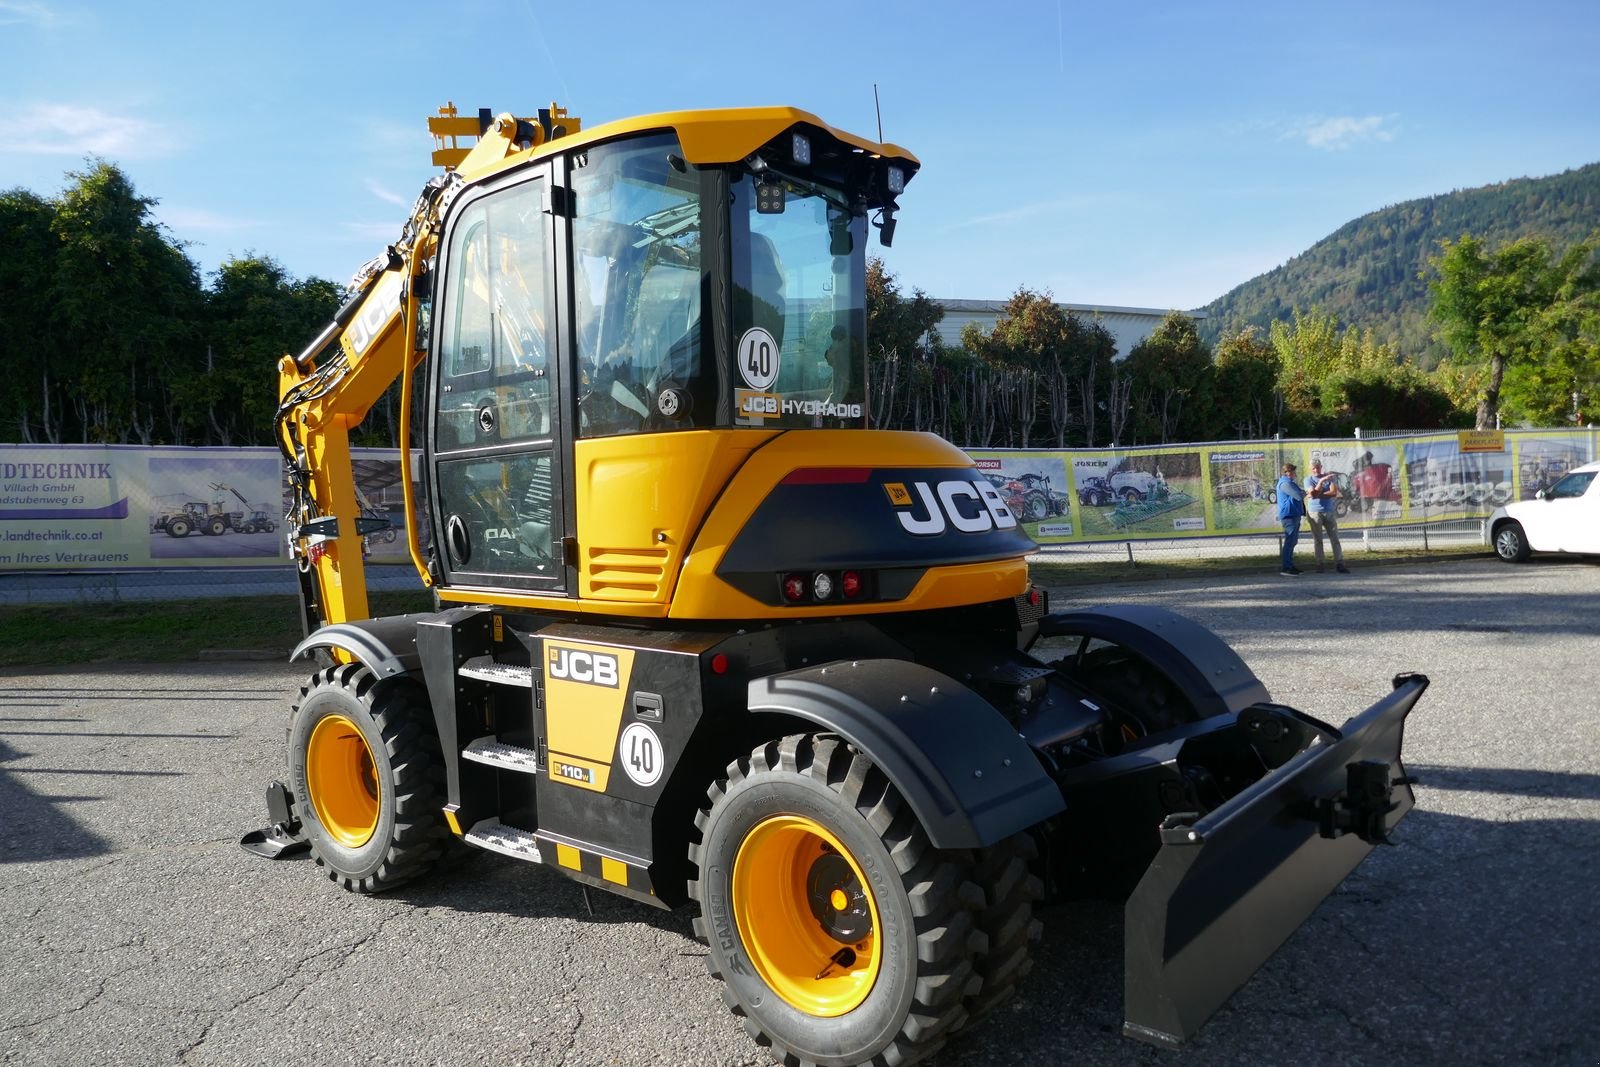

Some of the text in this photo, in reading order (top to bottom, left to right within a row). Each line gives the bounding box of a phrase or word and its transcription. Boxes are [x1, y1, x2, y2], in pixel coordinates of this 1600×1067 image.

[749, 340, 770, 377] 40
[743, 396, 860, 418] JCB HYDRADIG
[0, 463, 112, 479] DTECHNIK
[4, 483, 76, 492] Villach GmbH
[71, 495, 85, 504] 63
[896, 480, 1017, 534] JCB
[16, 552, 51, 563] Ihres
[55, 551, 129, 563] Vertrauens
[550, 650, 618, 686] JCB
[630, 735, 654, 774] 40
[711, 895, 735, 951] CAMSO
